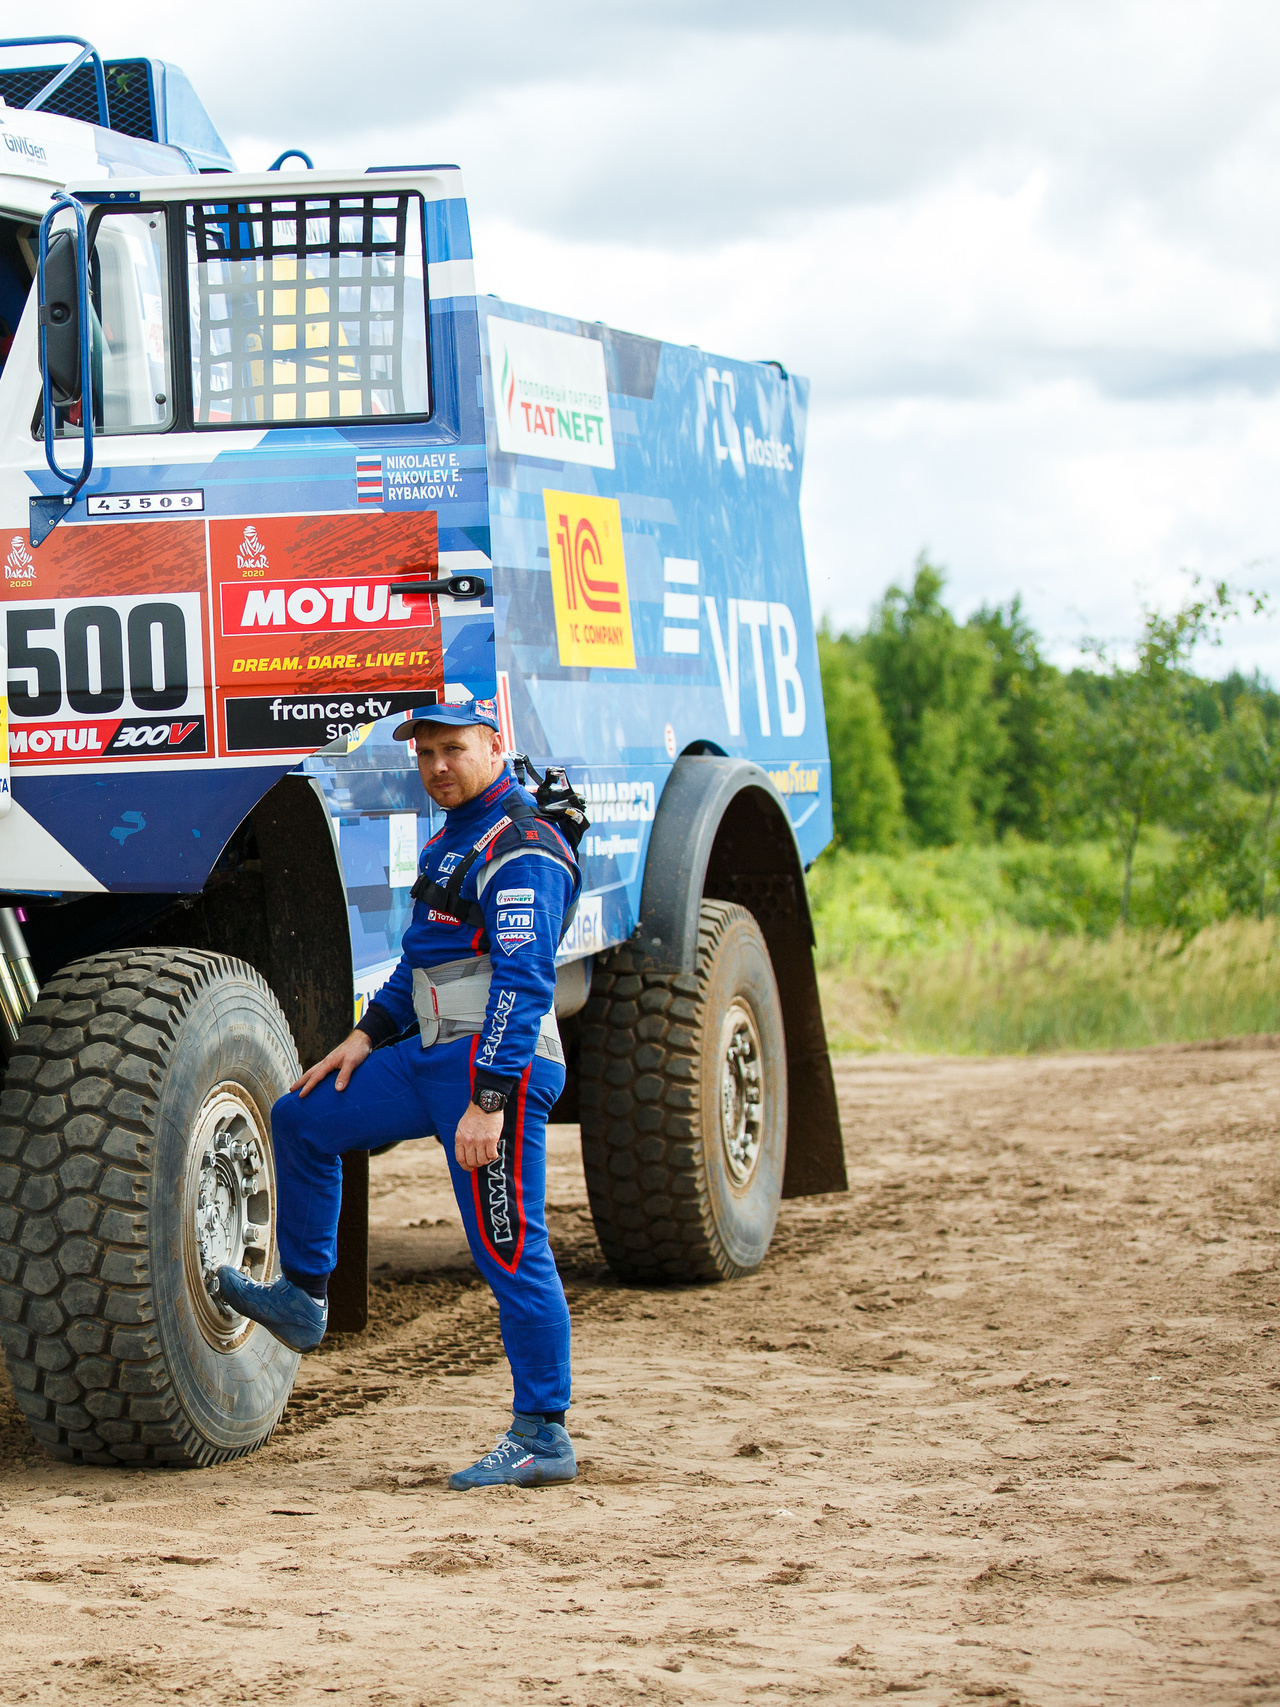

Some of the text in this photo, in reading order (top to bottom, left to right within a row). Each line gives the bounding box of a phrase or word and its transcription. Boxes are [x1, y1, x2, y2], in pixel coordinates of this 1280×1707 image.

[520, 401, 604, 446] TATNEFT
[744, 426, 794, 472] Rostec
[386, 453, 460, 469] NIKOLAEV E.
[387, 469, 463, 485] YAKOVLEV E.
[388, 485, 458, 500] RYBAKOV V.
[4, 564, 37, 579] DAKAR
[236, 554, 270, 569] DAKAR
[10, 580, 32, 588] 2020
[584, 624, 624, 646] COMPANY
[6, 602, 189, 717] 500
[232, 650, 430, 673] DREAM. DARE. LIVE IT.
[704, 596, 806, 737] VTB
[113, 722, 200, 748] 300V
[585, 781, 655, 824] WABCO
[478, 820, 506, 847] SIMPSON
[437, 912, 459, 923] TOTAL
[508, 915, 530, 926] VTB
